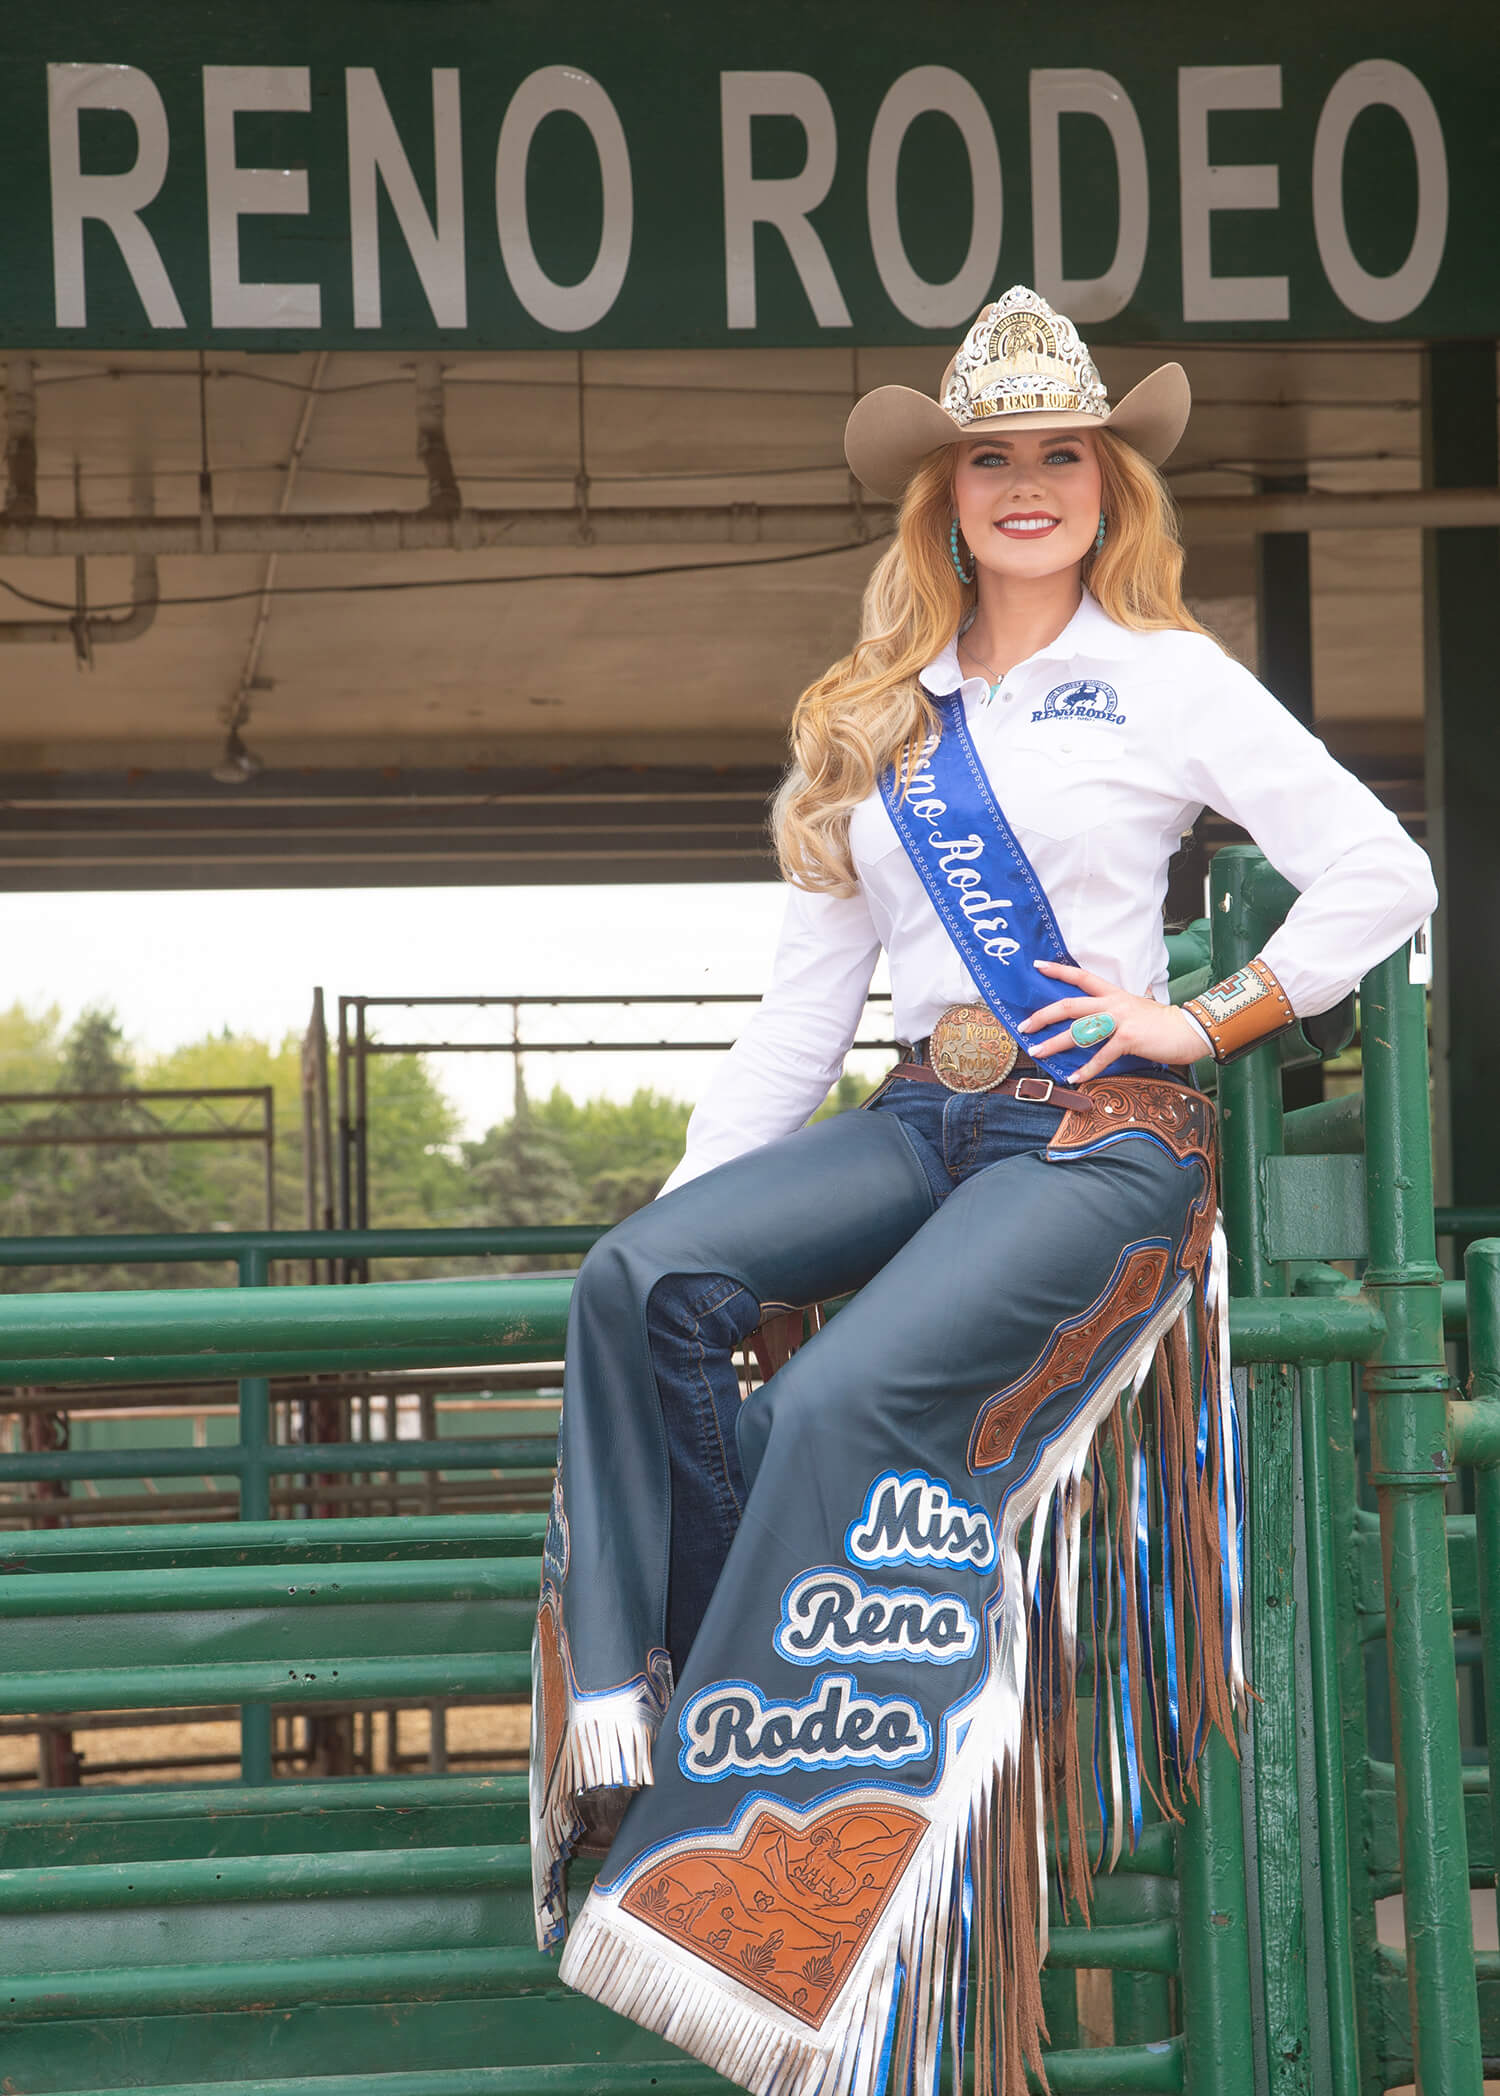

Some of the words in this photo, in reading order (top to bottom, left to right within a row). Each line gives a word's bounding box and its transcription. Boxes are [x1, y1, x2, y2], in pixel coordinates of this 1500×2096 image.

[47, 62, 633, 332] RENO
[720, 59, 1449, 328] RODEO
[973, 399, 998, 417] MISS
[1003, 393, 1036, 409] RENO
[1043, 393, 1079, 409] RODEO
[1031, 708, 1074, 723] RENO
[1075, 706, 1126, 725] RODEO
[928, 832, 1020, 966] Rodeo
[958, 1049, 997, 1073] Rodeo
[965, 1022, 999, 1041] Reno
[857, 1484, 990, 1560] Miss
[788, 1582, 966, 1649] Reno
[693, 1686, 917, 1765] Rodeo
